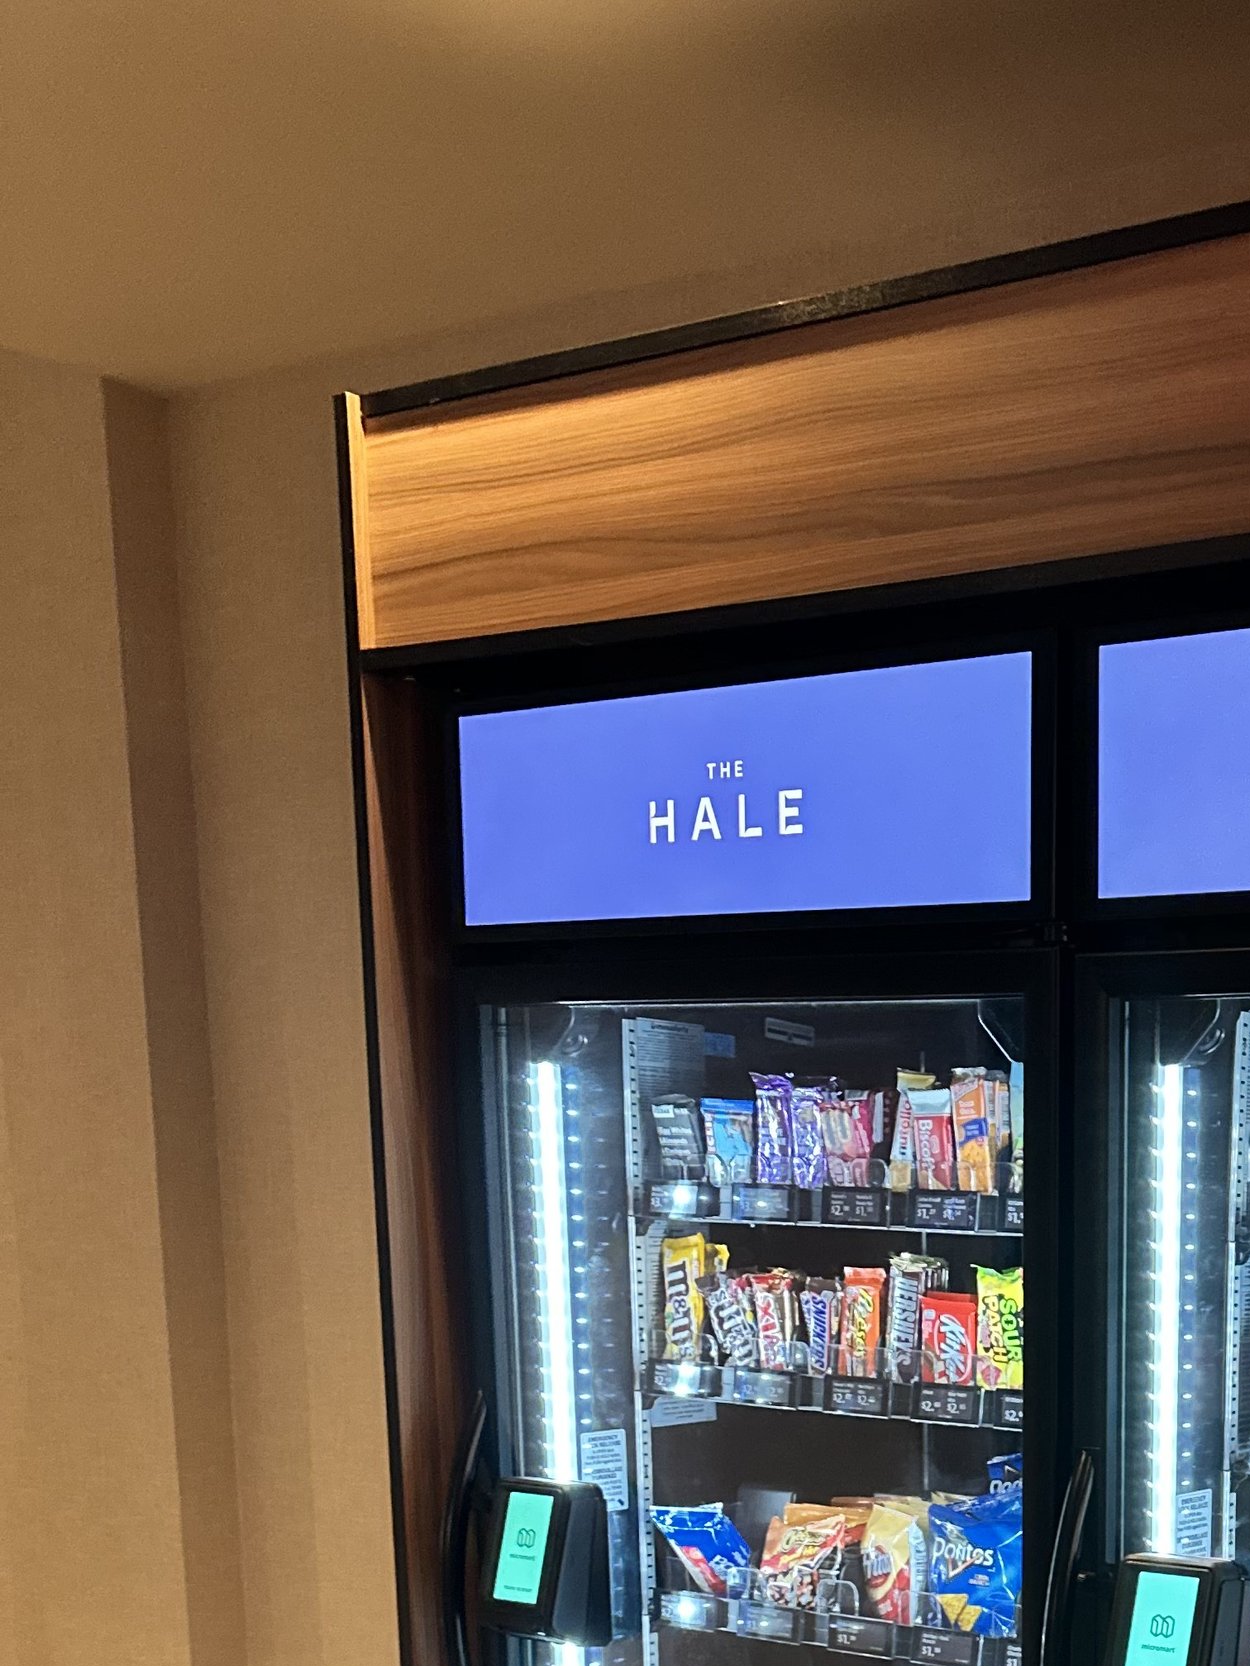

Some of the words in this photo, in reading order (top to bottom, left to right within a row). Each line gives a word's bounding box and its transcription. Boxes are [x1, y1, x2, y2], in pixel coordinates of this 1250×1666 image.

[706, 759, 744, 780] THE
[648, 788, 804, 844] HALE
[809, 1295, 828, 1370] SNICKERS
[982, 1294, 1009, 1364] PATCH
[1000, 1297, 1022, 1362] SOUR
[931, 1536, 994, 1568] Doritos
[1140, 1643, 1176, 1654] micromart
